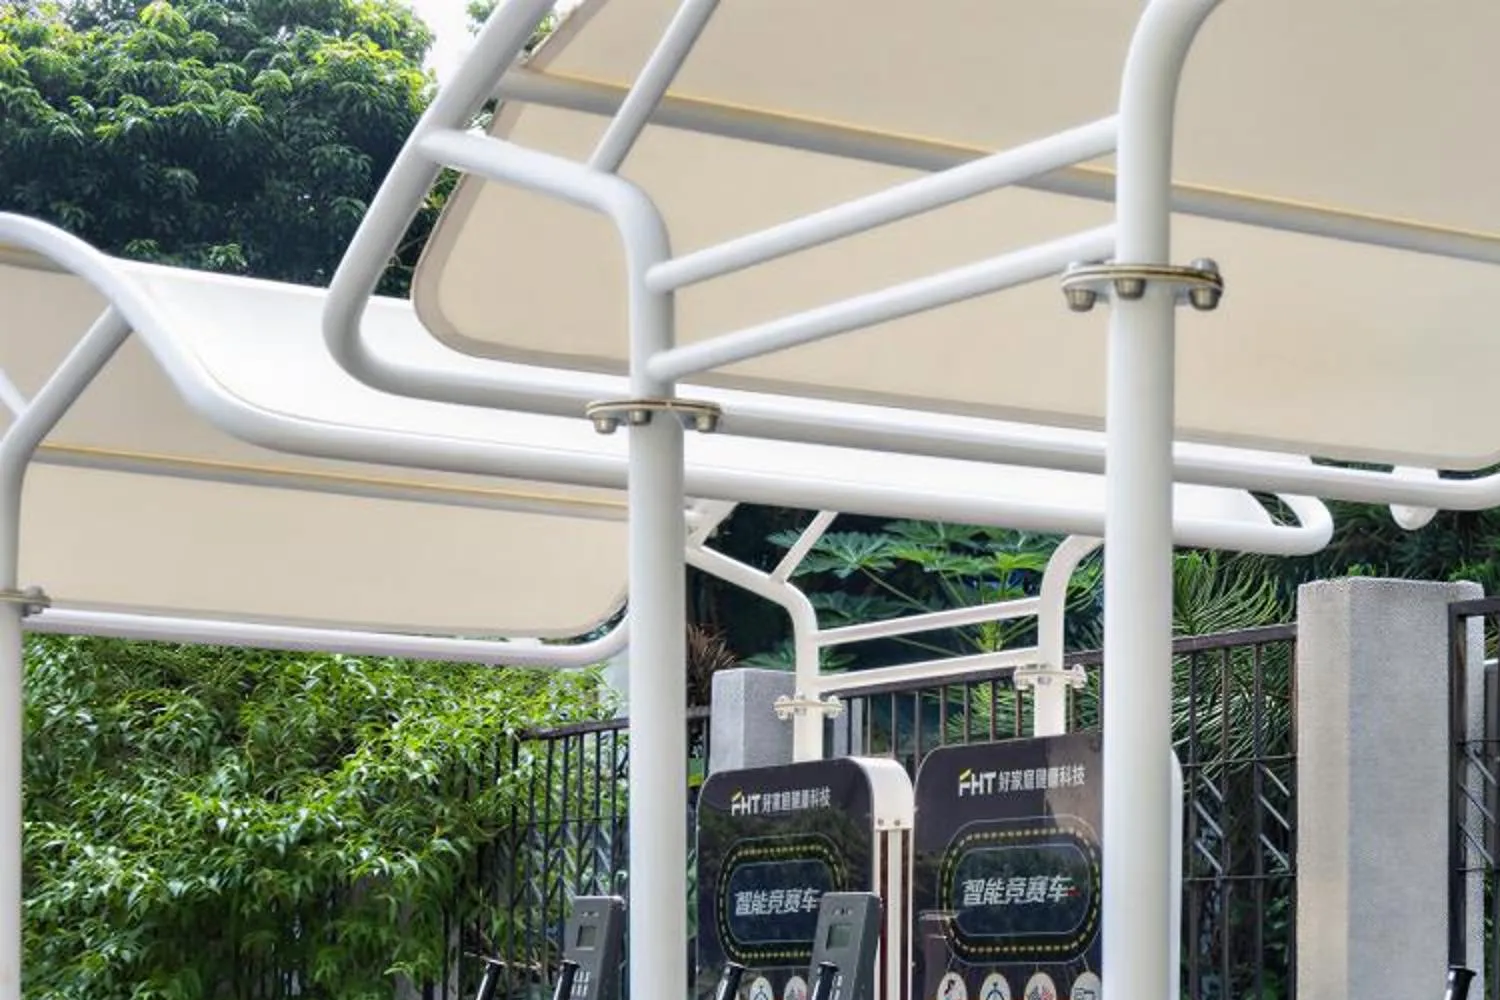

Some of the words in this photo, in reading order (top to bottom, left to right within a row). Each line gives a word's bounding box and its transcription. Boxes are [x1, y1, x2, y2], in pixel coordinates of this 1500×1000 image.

[733, 888, 821, 917] 智能竞赛车
[962, 874, 1075, 907] 智能竞赛车
